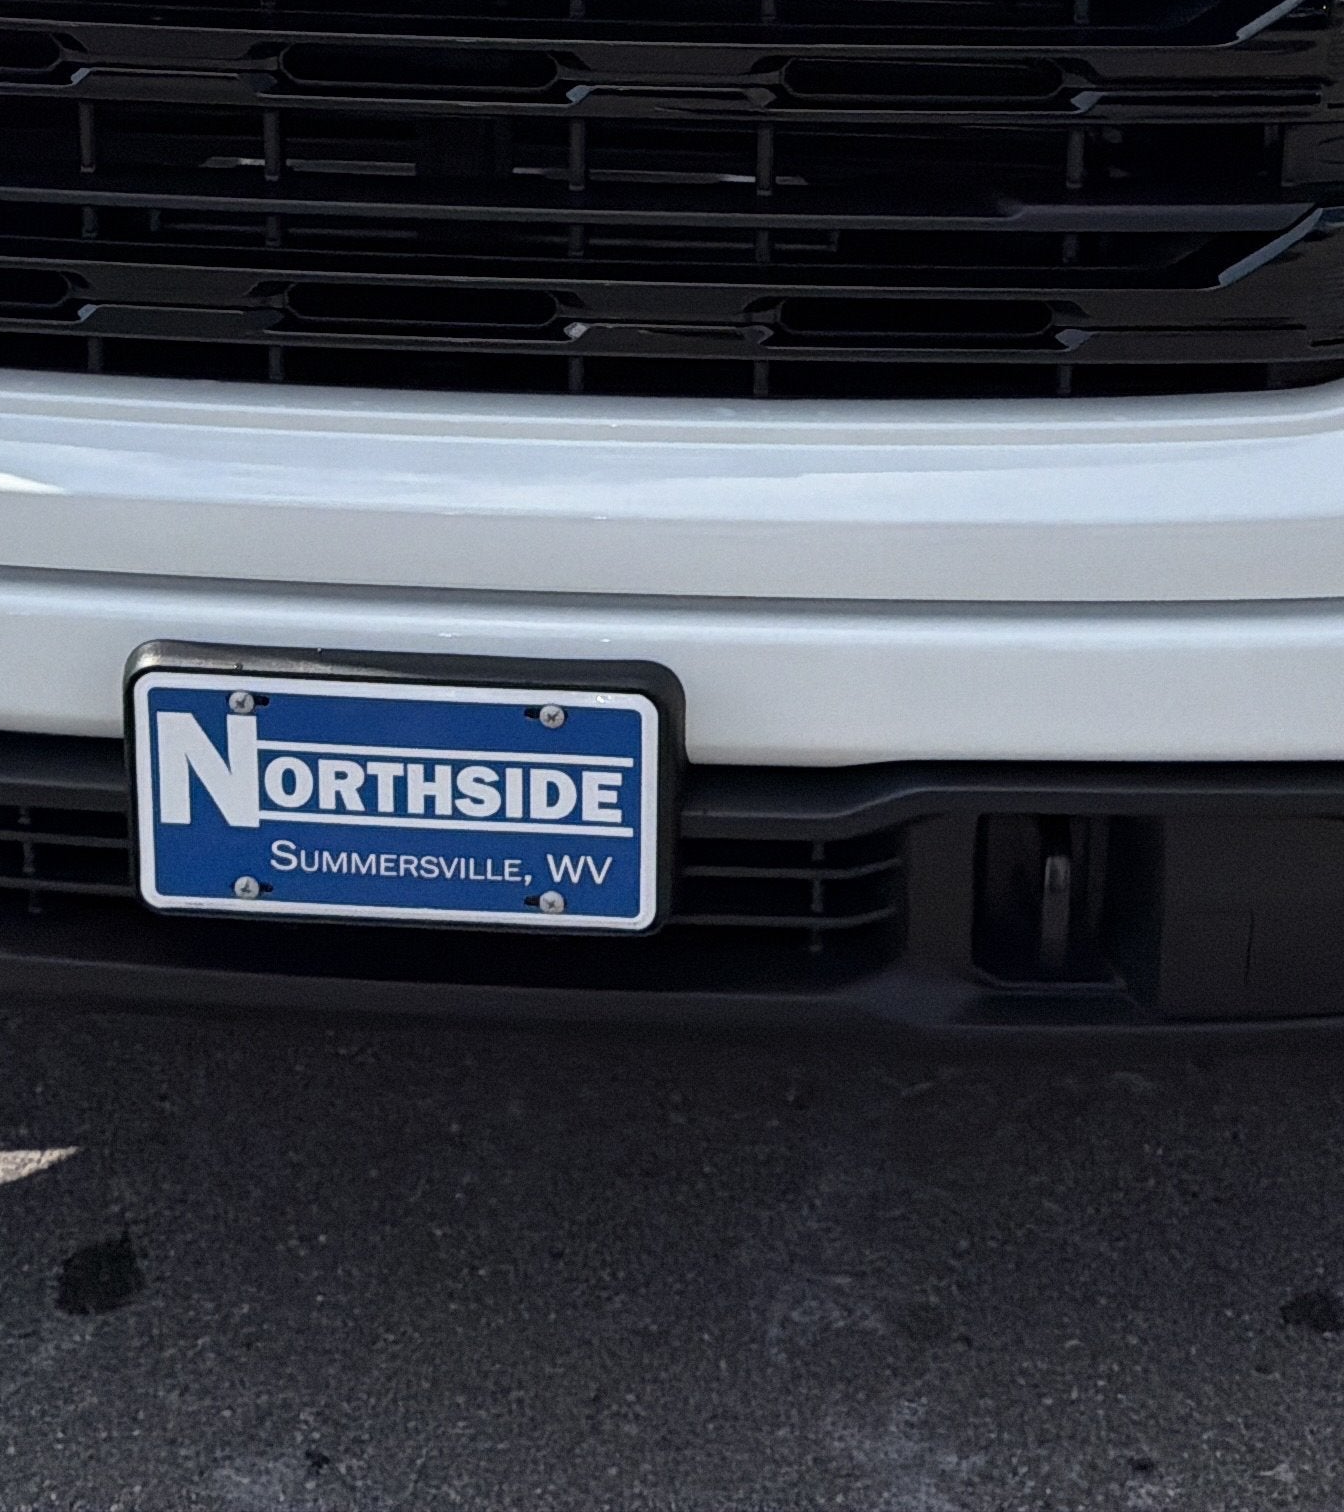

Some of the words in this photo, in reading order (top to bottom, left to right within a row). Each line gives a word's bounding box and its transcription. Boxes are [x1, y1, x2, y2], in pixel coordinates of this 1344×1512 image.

[156, 710, 624, 828] NORTHSIDE
[269, 839, 533, 886] SUMMERSVILLE,
[546, 852, 613, 885] WV
